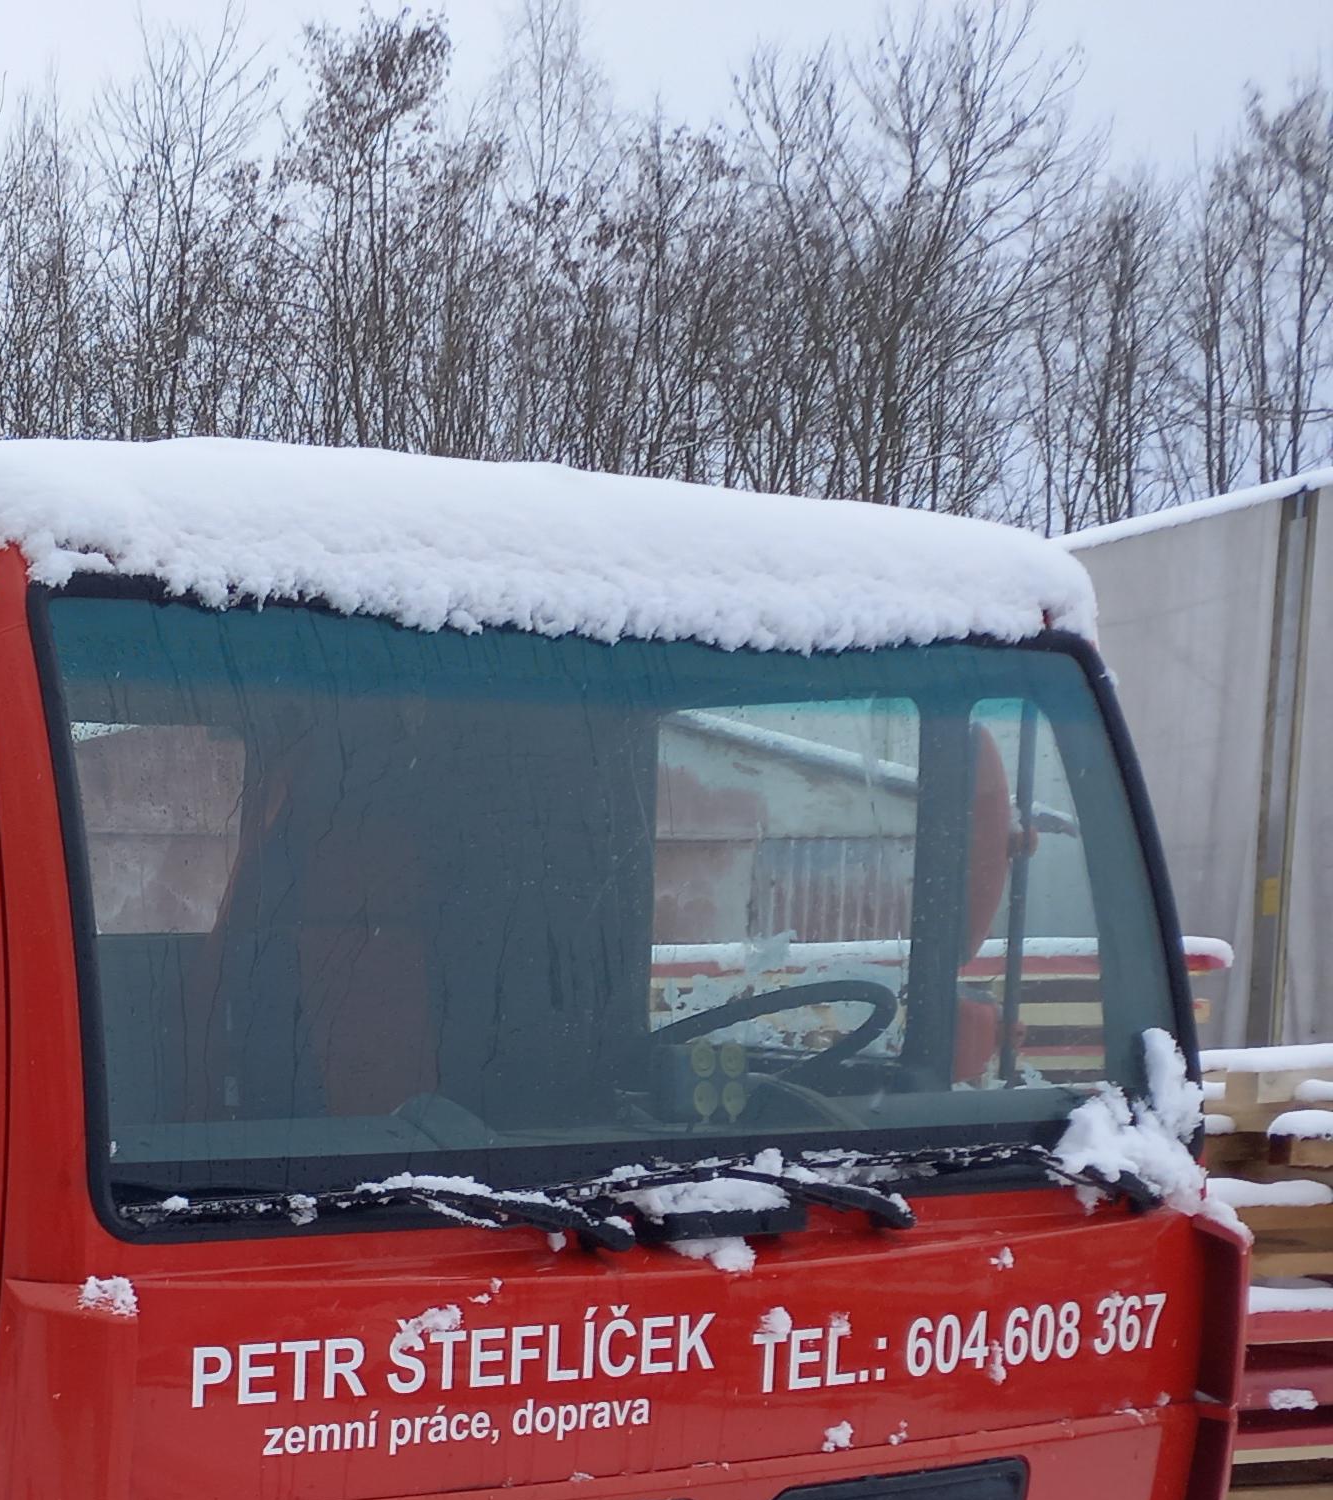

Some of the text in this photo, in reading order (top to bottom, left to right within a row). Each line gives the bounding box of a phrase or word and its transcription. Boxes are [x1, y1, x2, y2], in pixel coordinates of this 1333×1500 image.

[190, 1293, 1167, 1409] PETR ŠTEFLÍČEK TEL.: 604 608 367
[262, 1398, 651, 1456] zemní práce, doprava
